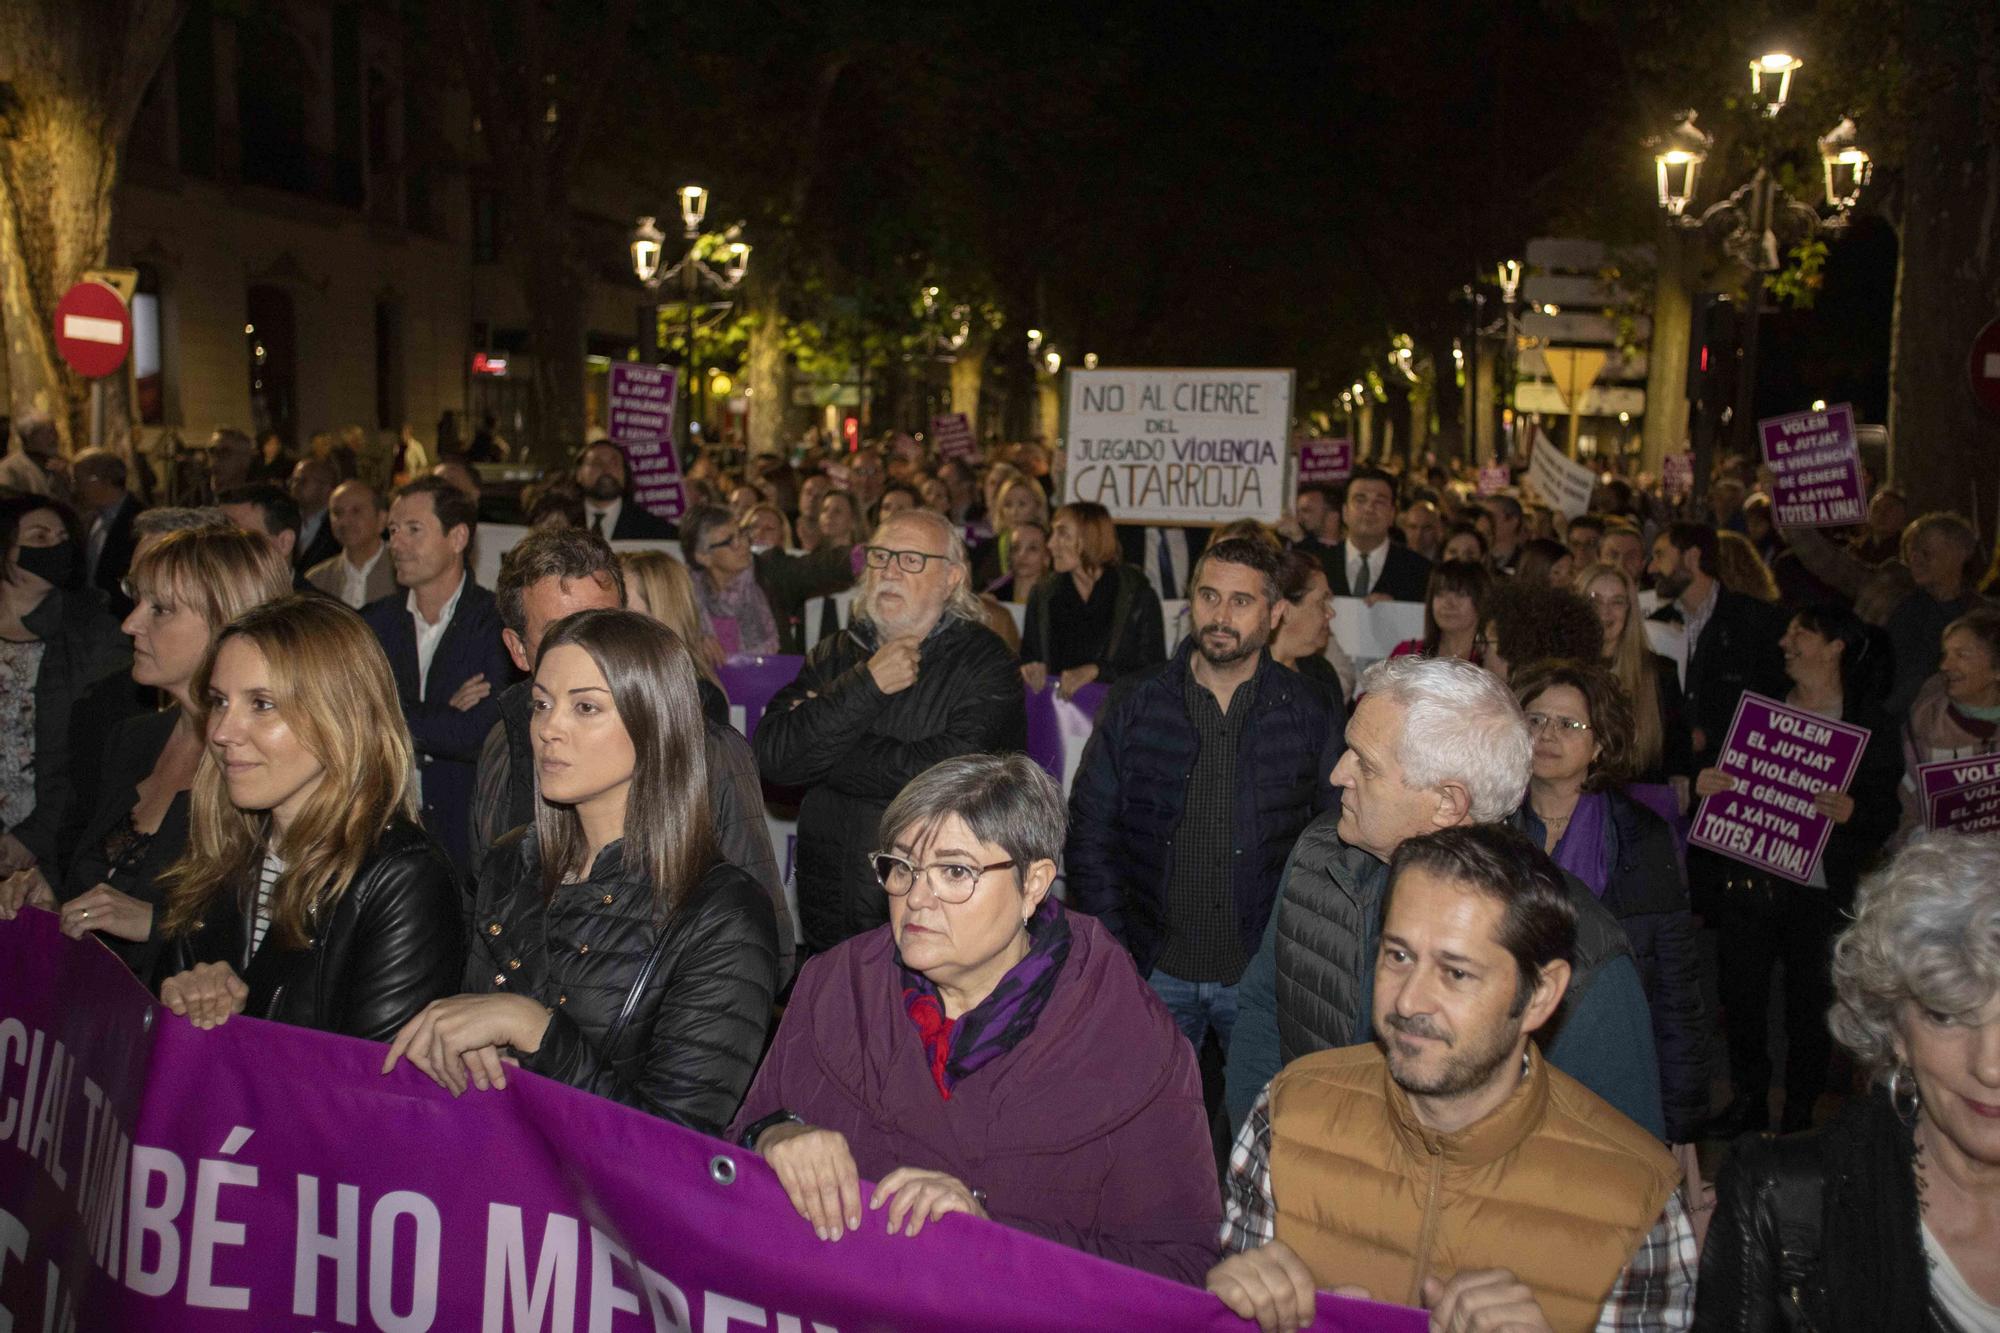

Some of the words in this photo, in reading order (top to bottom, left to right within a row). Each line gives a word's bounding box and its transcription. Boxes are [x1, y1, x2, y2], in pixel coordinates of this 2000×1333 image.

[1083, 385, 1125, 413] NO
[1140, 384, 1168, 411] AL
[1174, 382, 1262, 415] CIERRE
[1145, 419, 1179, 434] DEL
[1781, 414, 1830, 436] VOLEM
[1075, 438, 1165, 462] JUZGADO
[1074, 463, 1263, 508] CATARROJA
[1768, 711, 1833, 747] VOLEM
[1725, 748, 1749, 770] DE
[1747, 730, 1768, 750] EL
[1770, 739, 1836, 773] JUTJAT
[1725, 801, 1739, 818] A
[1950, 806, 1971, 820] EL
[1703, 813, 1751, 851] TOTES
[1753, 834, 1767, 860] A
[1767, 837, 1811, 875] UNA!
[292, 1173, 442, 1333] HO
